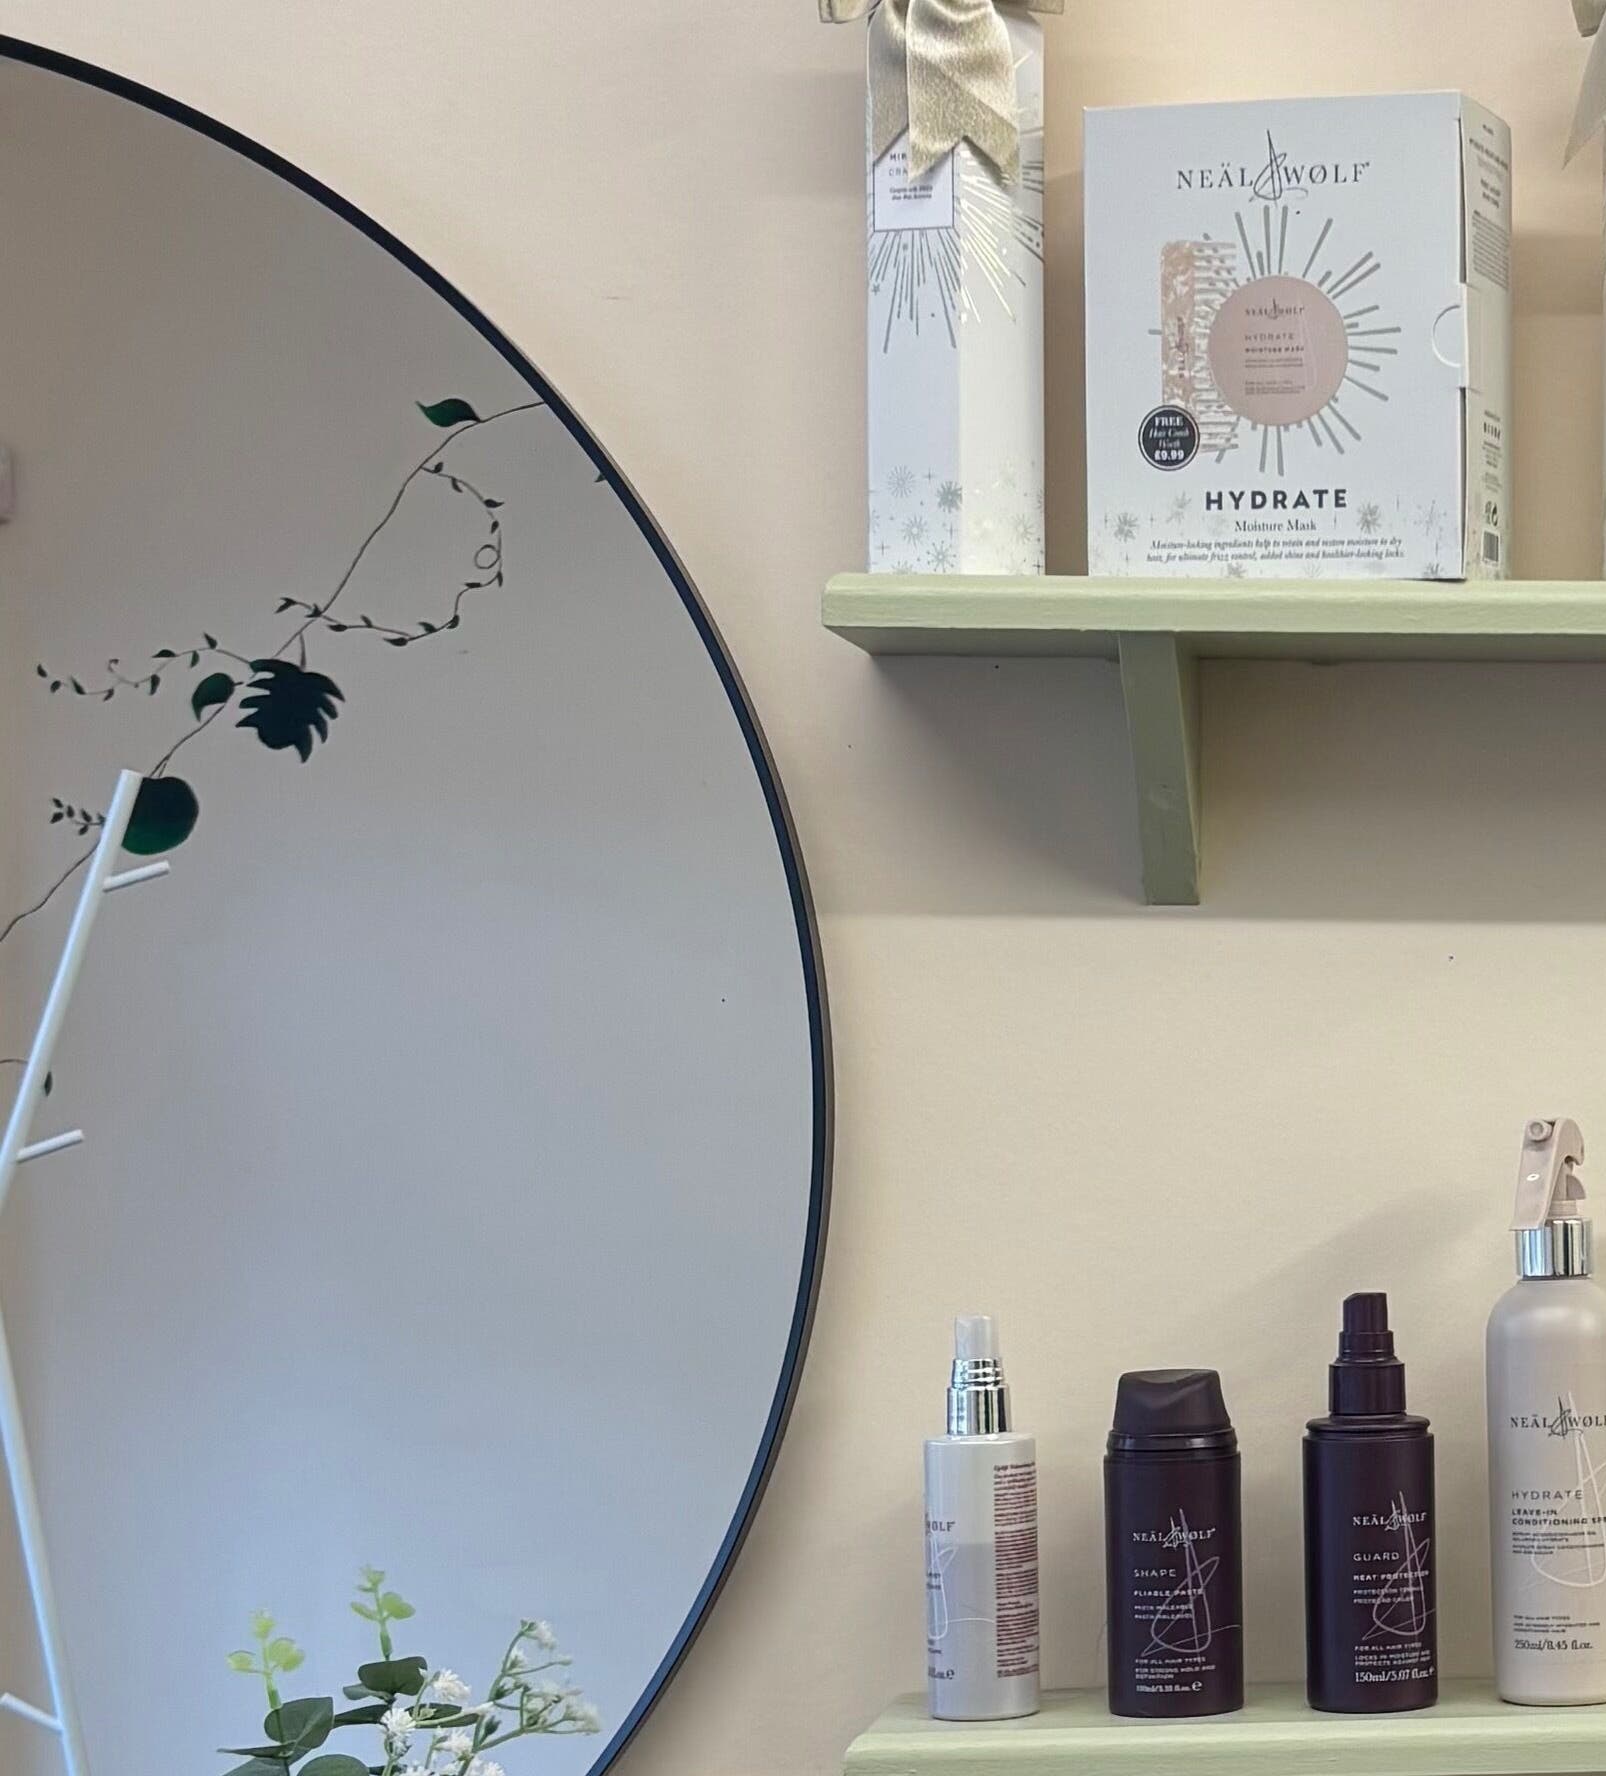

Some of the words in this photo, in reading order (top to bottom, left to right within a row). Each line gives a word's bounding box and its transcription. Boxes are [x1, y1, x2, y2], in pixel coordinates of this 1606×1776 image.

[1176, 162, 1253, 190] NEÄL
[1205, 488, 1348, 511] HYDRATE
[1234, 519, 1284, 532] Moisture
[1286, 517, 1318, 531] Mask
[1511, 1489, 1584, 1501] HYDRATE
[1511, 1508, 1558, 1517] LEAVE-IN
[1511, 1517, 1589, 1527] CONDITIONING
[1353, 1552, 1400, 1562] GUARD
[1134, 1569, 1177, 1578] SHAPE
[1353, 1574, 1378, 1582] HEAT
